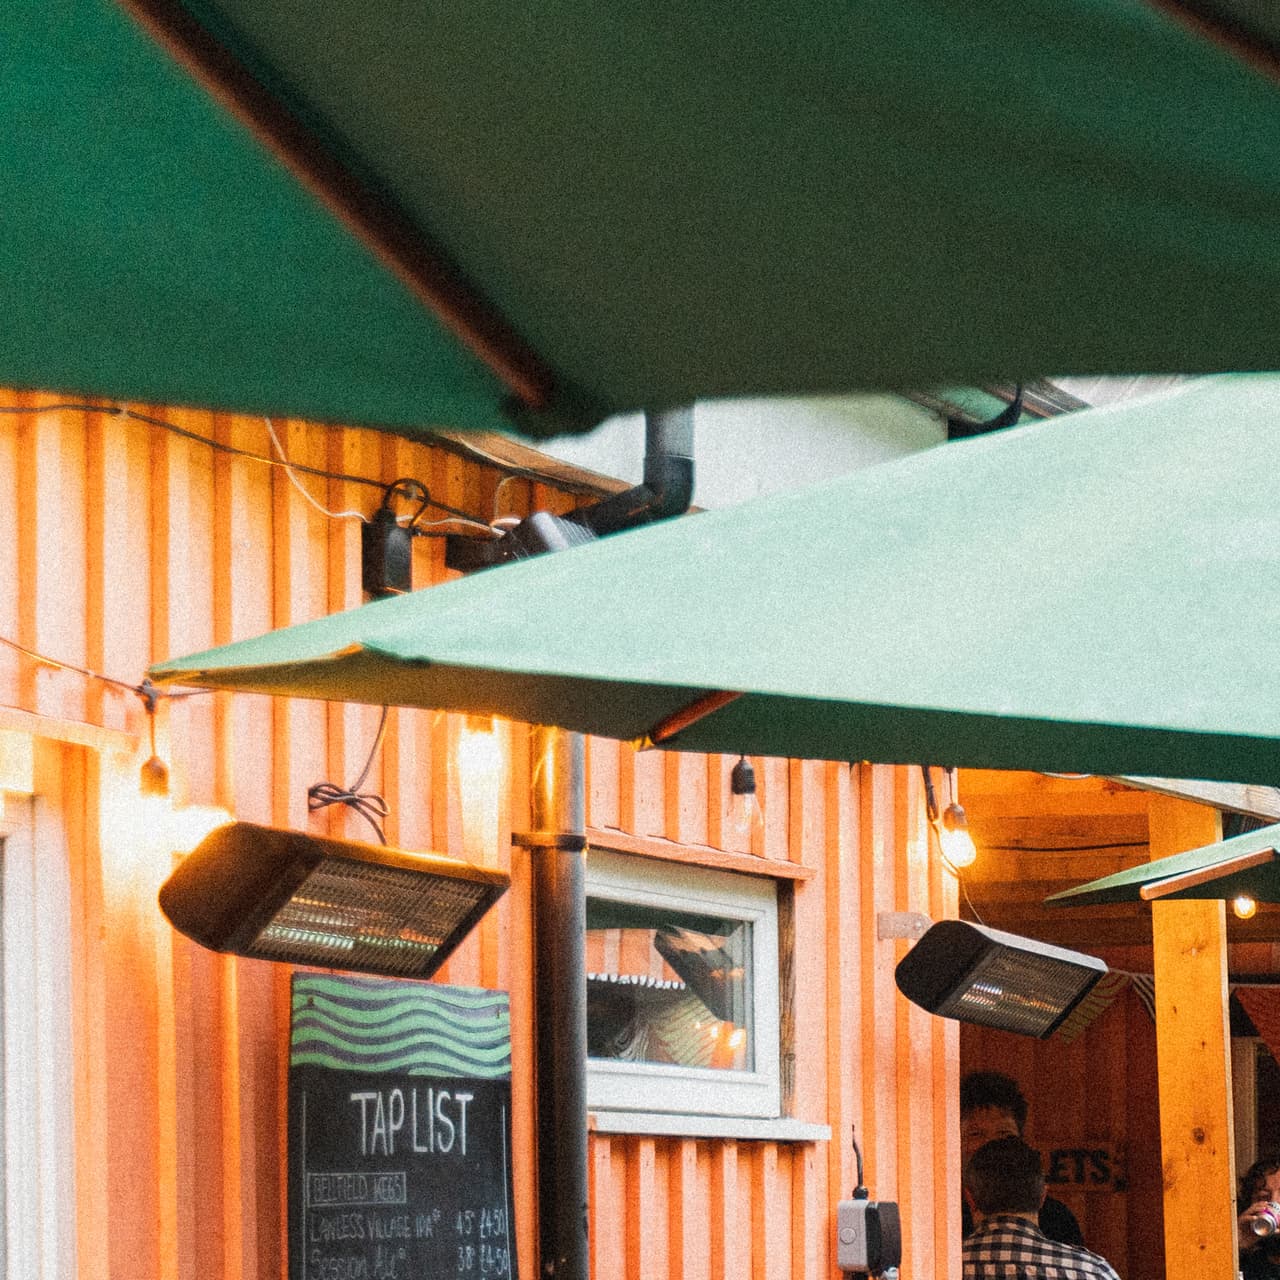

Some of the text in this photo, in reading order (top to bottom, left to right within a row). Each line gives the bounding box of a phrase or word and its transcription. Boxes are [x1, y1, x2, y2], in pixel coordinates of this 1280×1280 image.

[351, 1087, 474, 1156] TAP LIST
[1045, 1148, 1111, 1185] ETS
